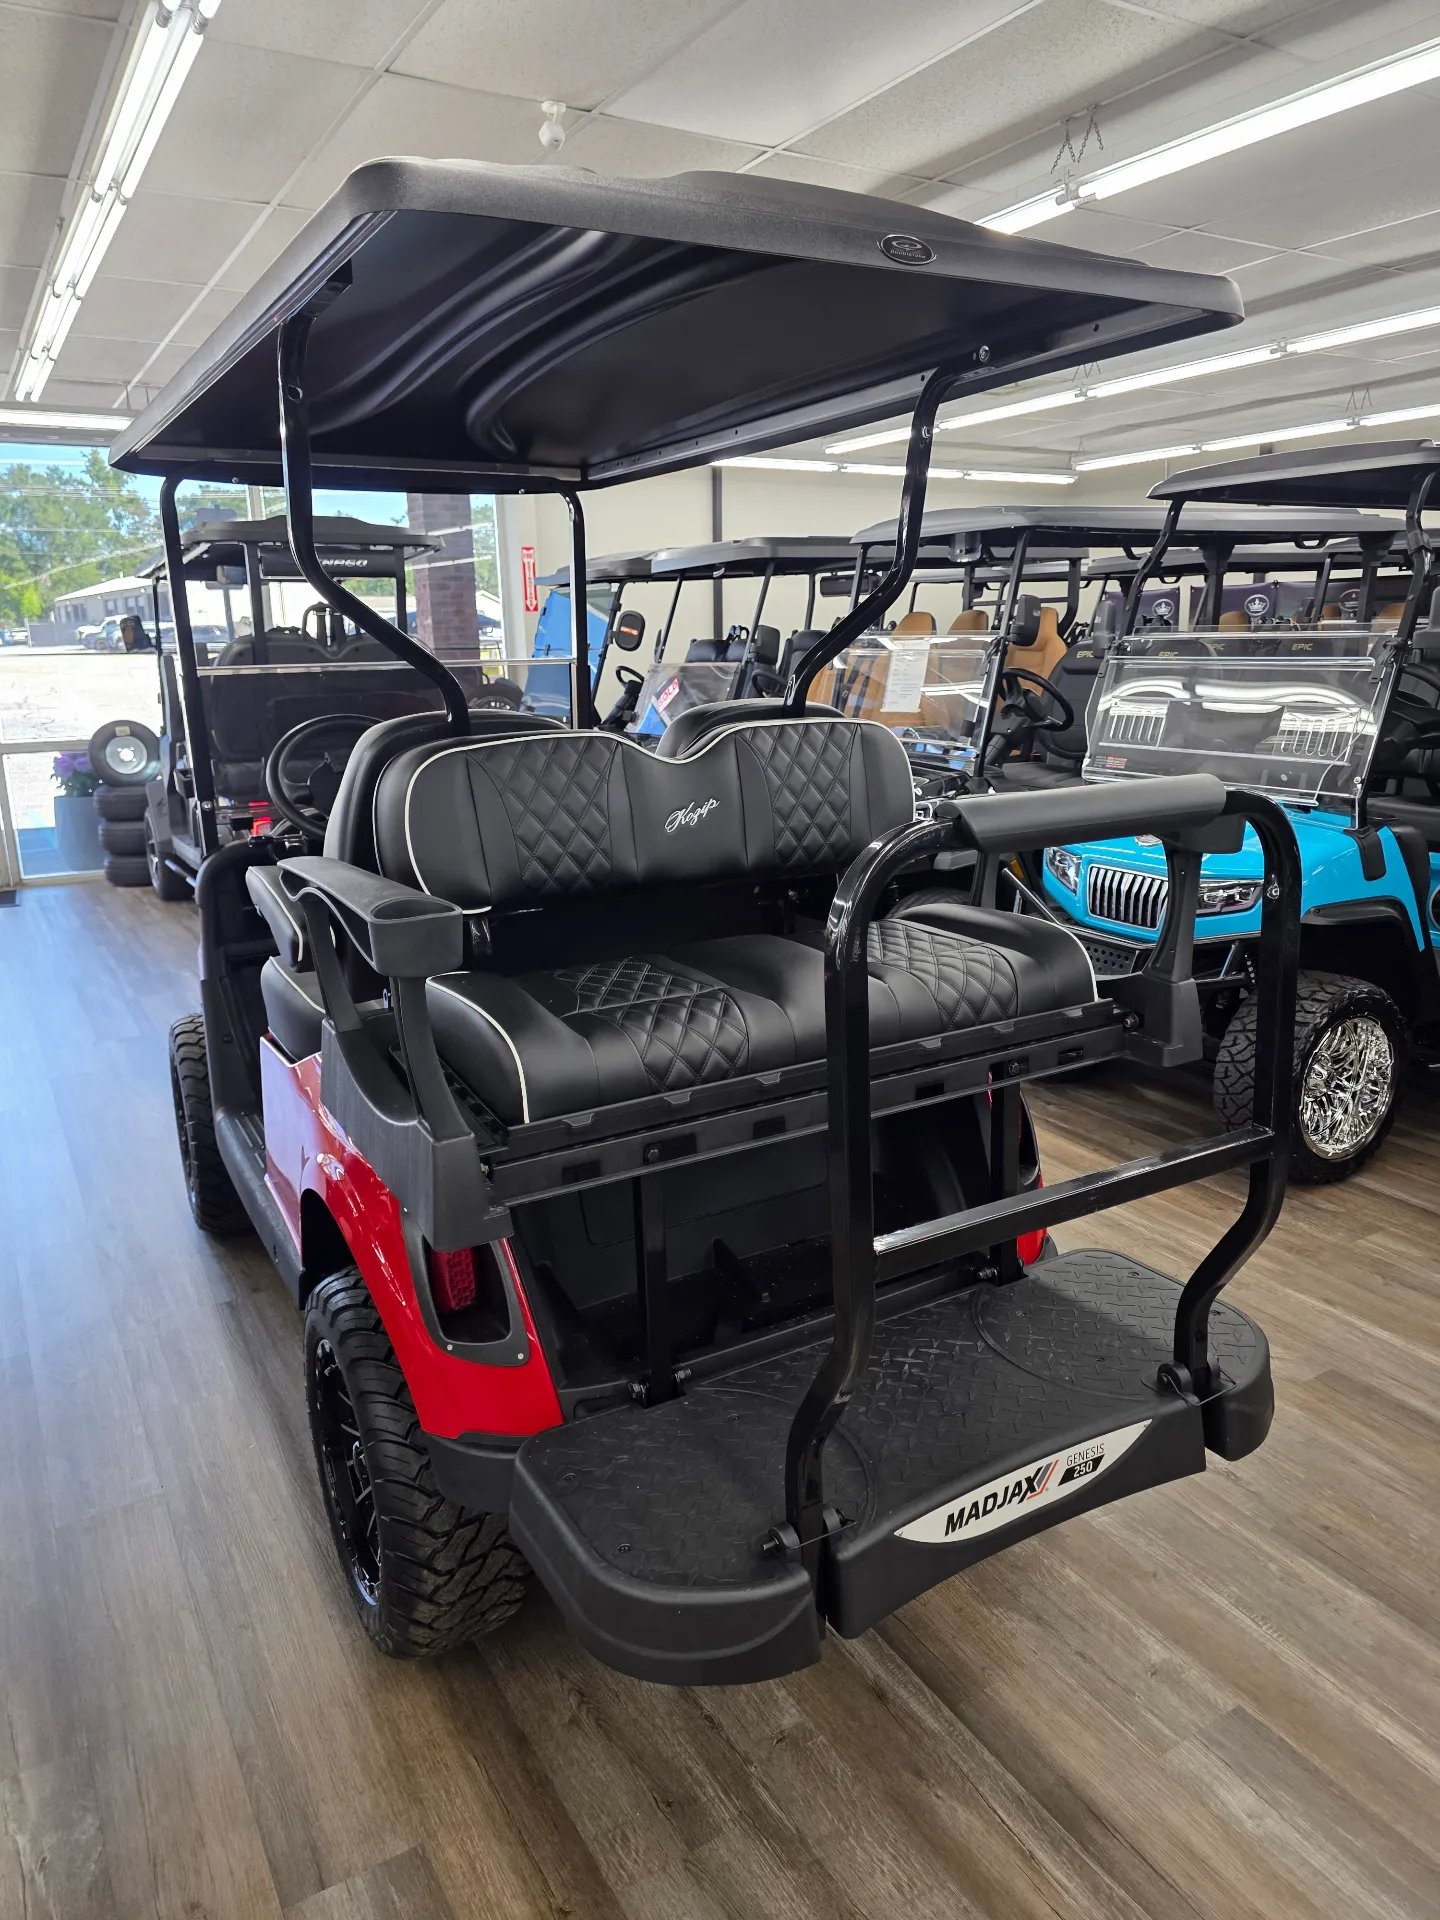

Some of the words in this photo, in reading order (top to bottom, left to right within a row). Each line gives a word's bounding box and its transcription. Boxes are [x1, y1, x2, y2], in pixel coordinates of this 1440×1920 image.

[1076, 650, 1095, 659] EPIC
[1291, 643, 1313, 651] EPIC
[1066, 1442, 1105, 1467] GENESIS
[1073, 1460, 1093, 1478] 250
[944, 1463, 1046, 1538] MADJAX
